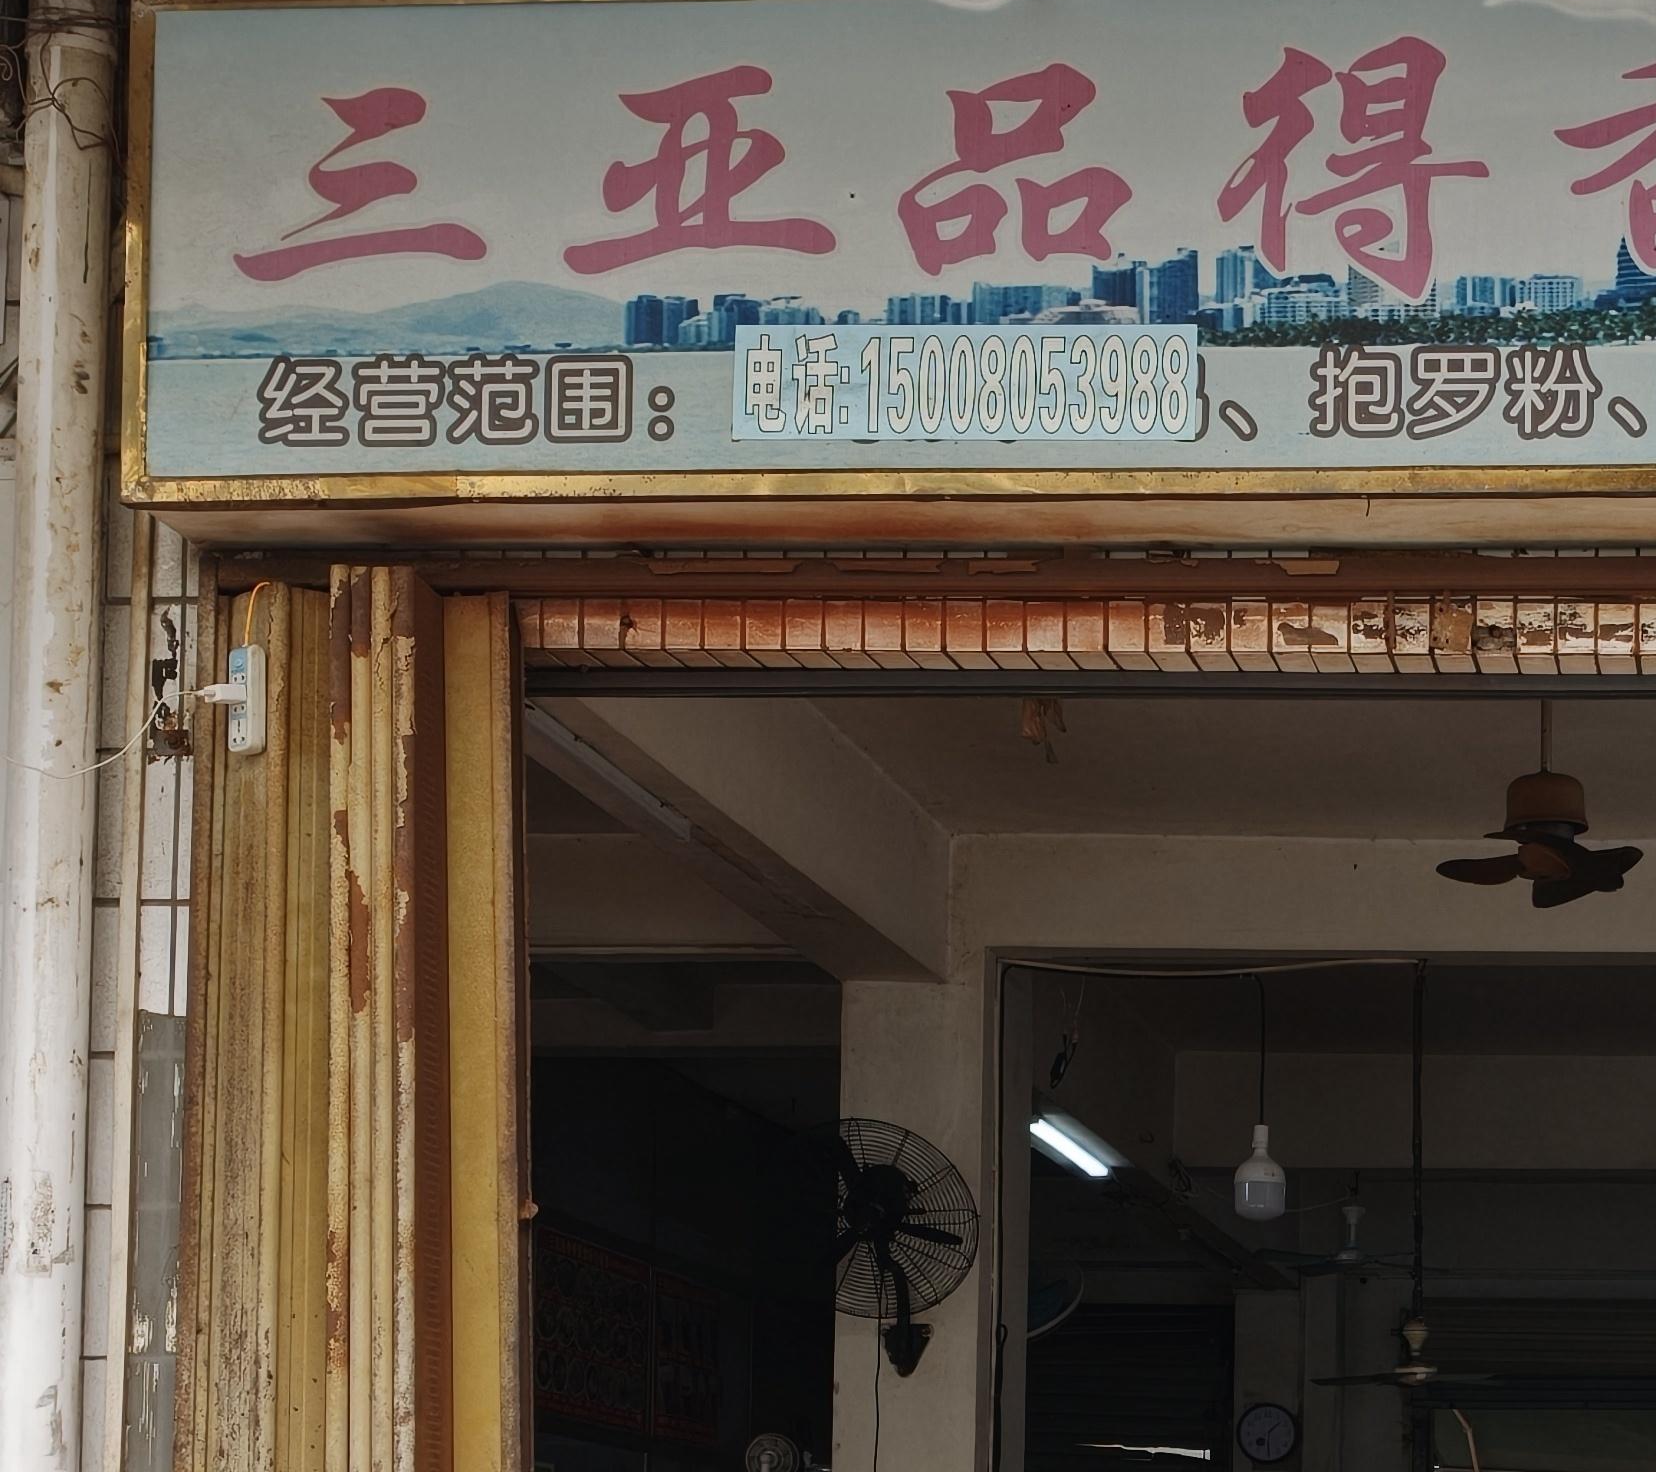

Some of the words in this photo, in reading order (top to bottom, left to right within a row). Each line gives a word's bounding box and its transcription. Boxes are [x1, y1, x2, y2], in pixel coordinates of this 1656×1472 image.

[258, 354, 675, 447] 经营范围：
[744, 334, 1188, 435] 电话:15008053988
